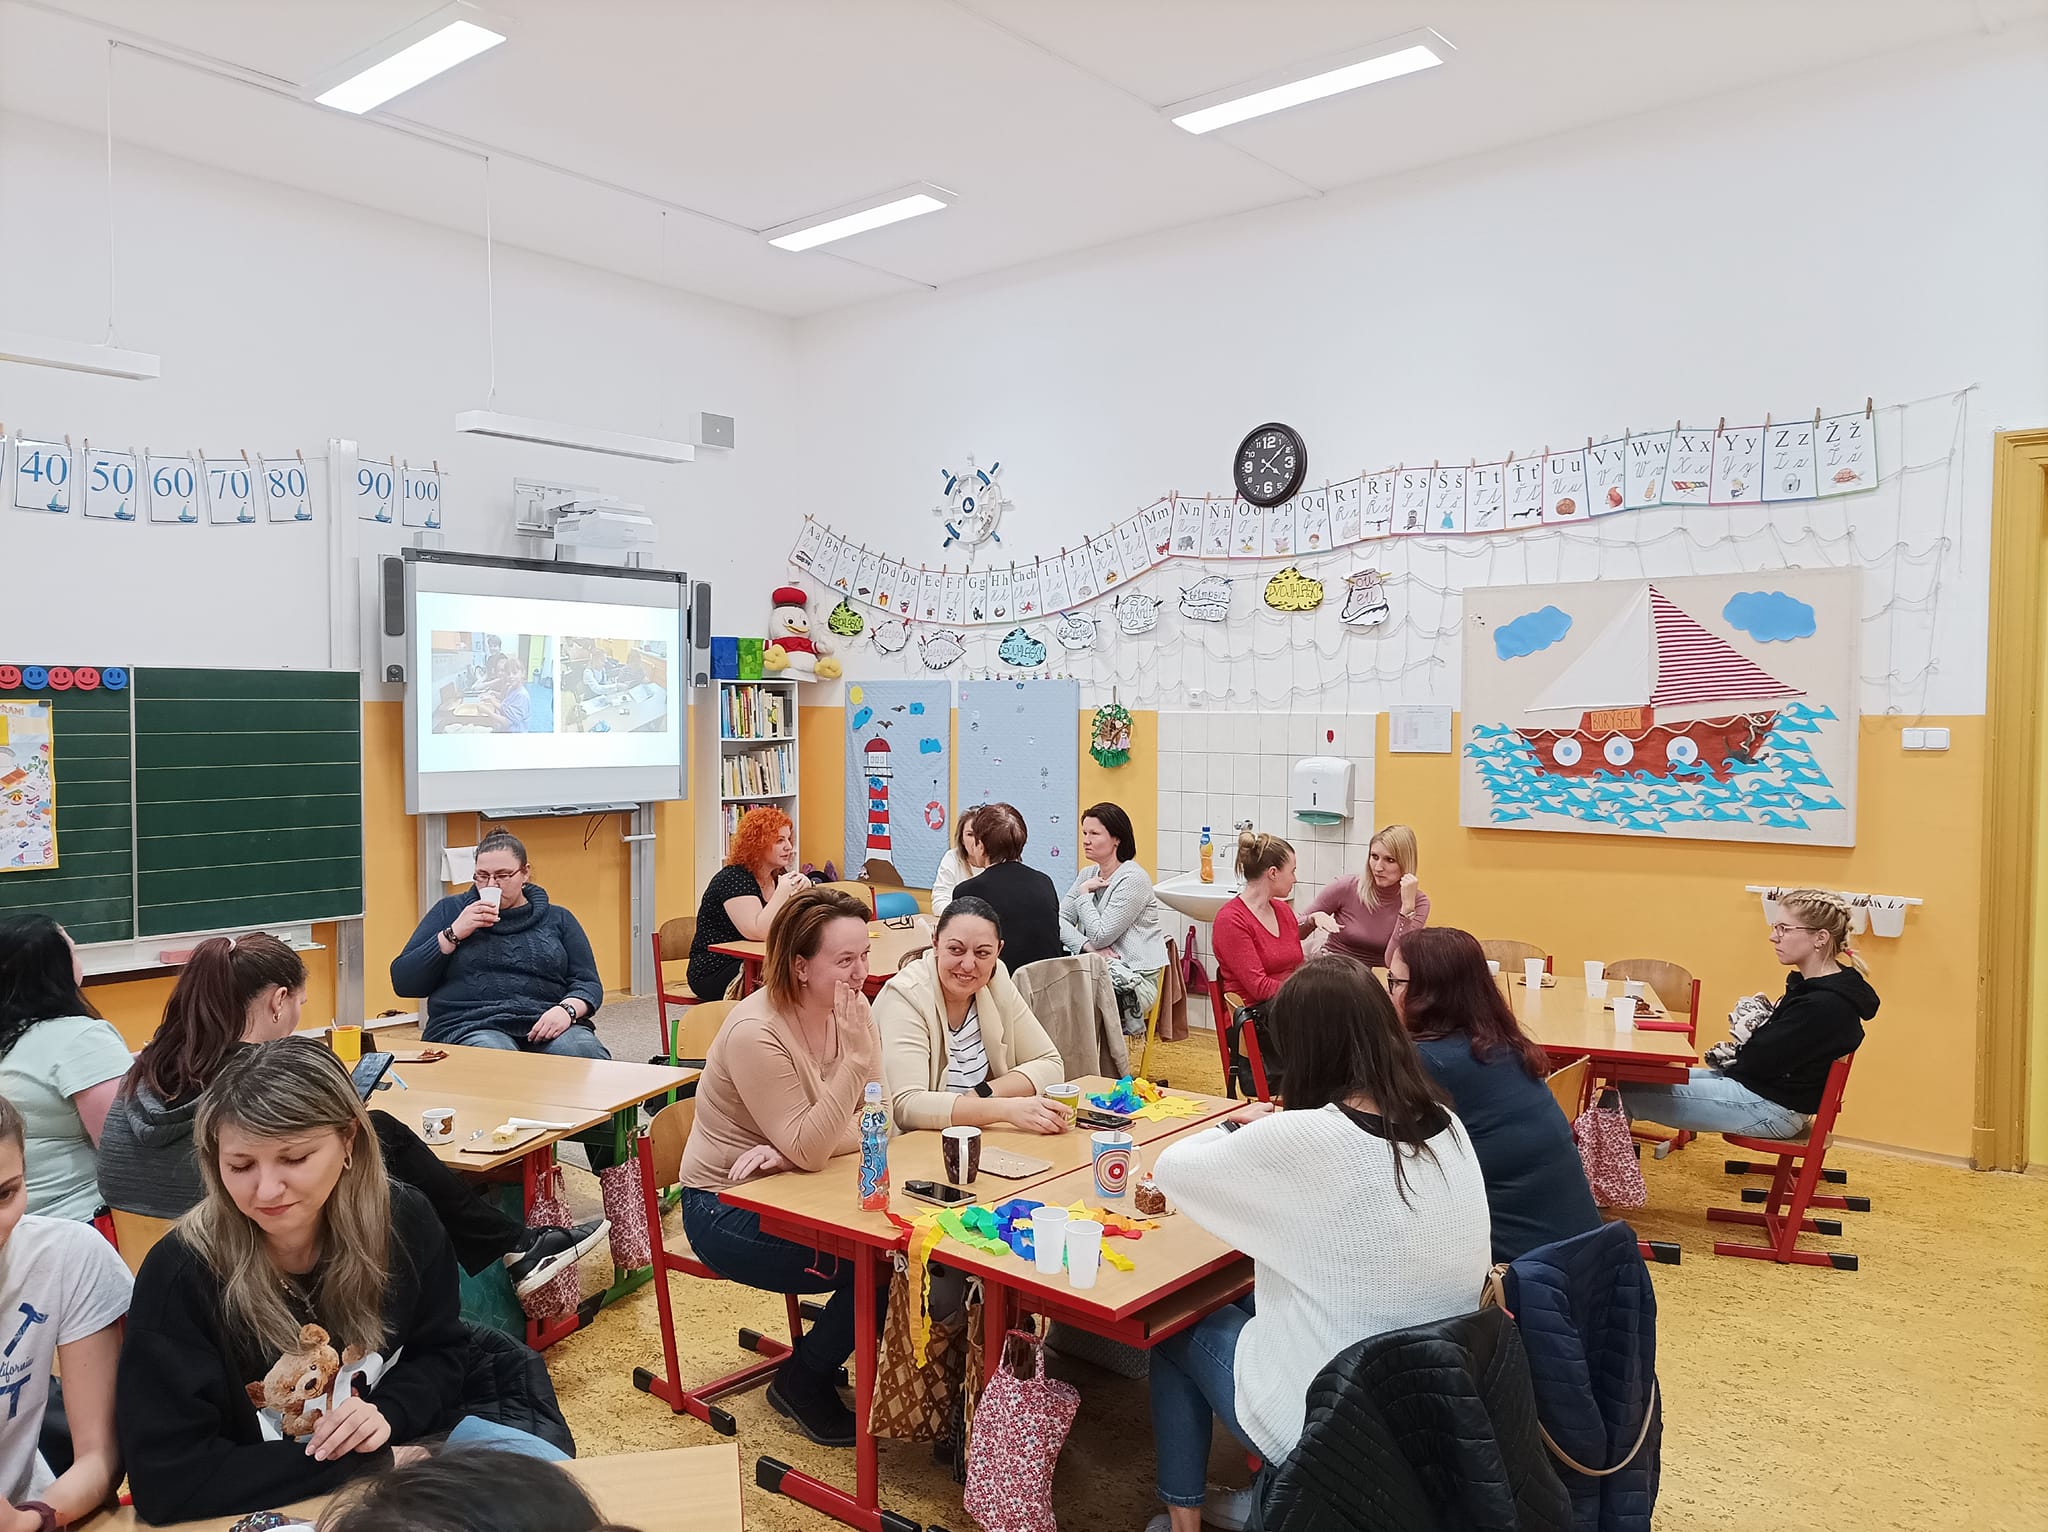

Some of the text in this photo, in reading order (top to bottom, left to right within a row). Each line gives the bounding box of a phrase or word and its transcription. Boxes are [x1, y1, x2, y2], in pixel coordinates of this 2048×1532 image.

[1262, 436, 1276, 449] 12
[20, 451, 67, 485] 40
[1244, 461, 1253, 473] 9
[1284, 456, 1294, 469] 3
[91, 461, 133, 494] 50
[153, 467, 193, 498] 60
[210, 469, 249, 499] 70
[268, 469, 305, 497] 80
[357, 468, 392, 499] 90
[1263, 481, 1273, 494] 6
[405, 479, 438, 501] 100
[1355, 577, 1375, 587] ou
[1356, 592, 1378, 606] eu
